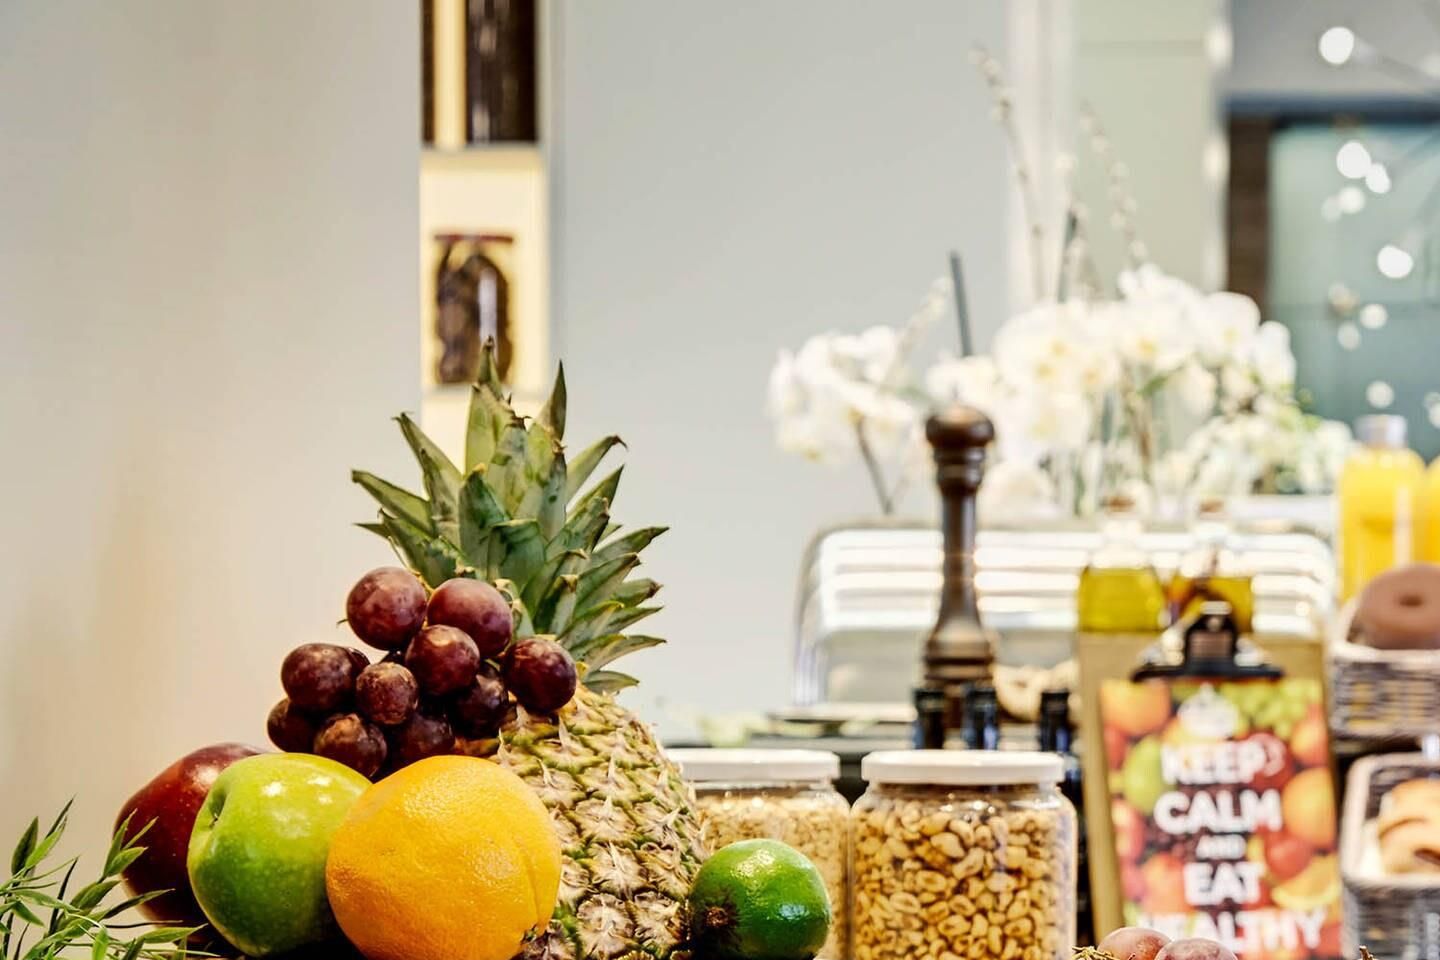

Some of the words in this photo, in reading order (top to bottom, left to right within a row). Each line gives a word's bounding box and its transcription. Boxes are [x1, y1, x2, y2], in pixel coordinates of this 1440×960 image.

[1161, 742, 1266, 784] KEEP
[1154, 789, 1283, 834] CALM
[1183, 862, 1264, 906] EAT
